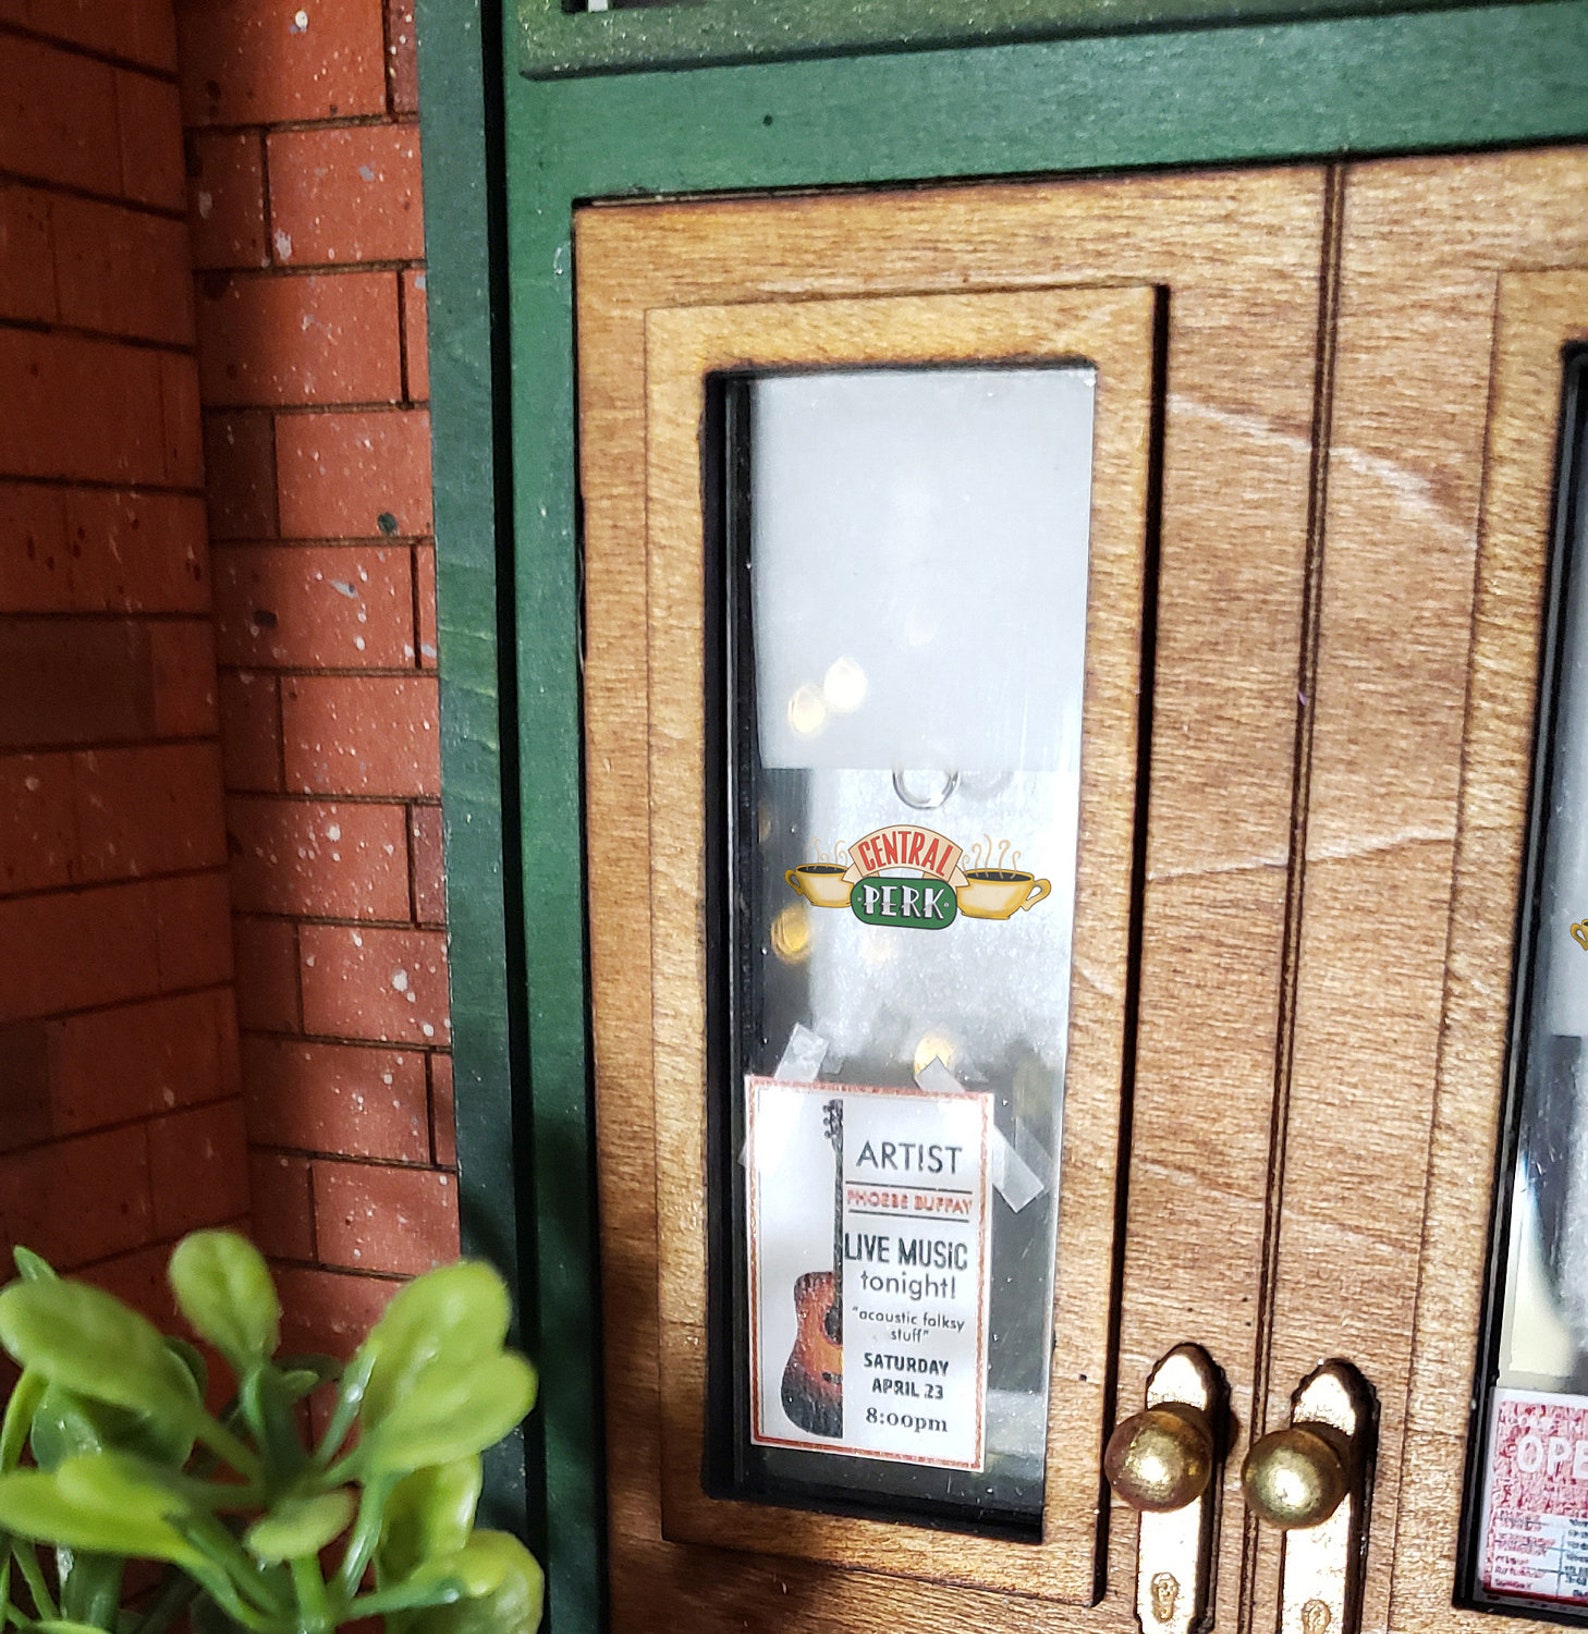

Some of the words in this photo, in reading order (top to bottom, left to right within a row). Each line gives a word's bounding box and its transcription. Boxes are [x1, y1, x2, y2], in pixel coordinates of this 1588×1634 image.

[858, 831, 953, 877] CENTRAL
[863, 885, 944, 920] PERK
[856, 1140, 962, 1175] ARTIST
[847, 1190, 908, 1210] PHOEBE
[914, 1195, 973, 1214] BUFFAY
[844, 1232, 889, 1263] LIVE
[898, 1237, 968, 1271] MUSIC
[861, 1270, 956, 1301] tonight!
[923, 1312, 965, 1333] folksy
[863, 1352, 949, 1377] SATURDAY
[872, 1378, 919, 1398] APRIL
[924, 1383, 944, 1400] 23
[866, 1407, 948, 1433] 8:00pm
